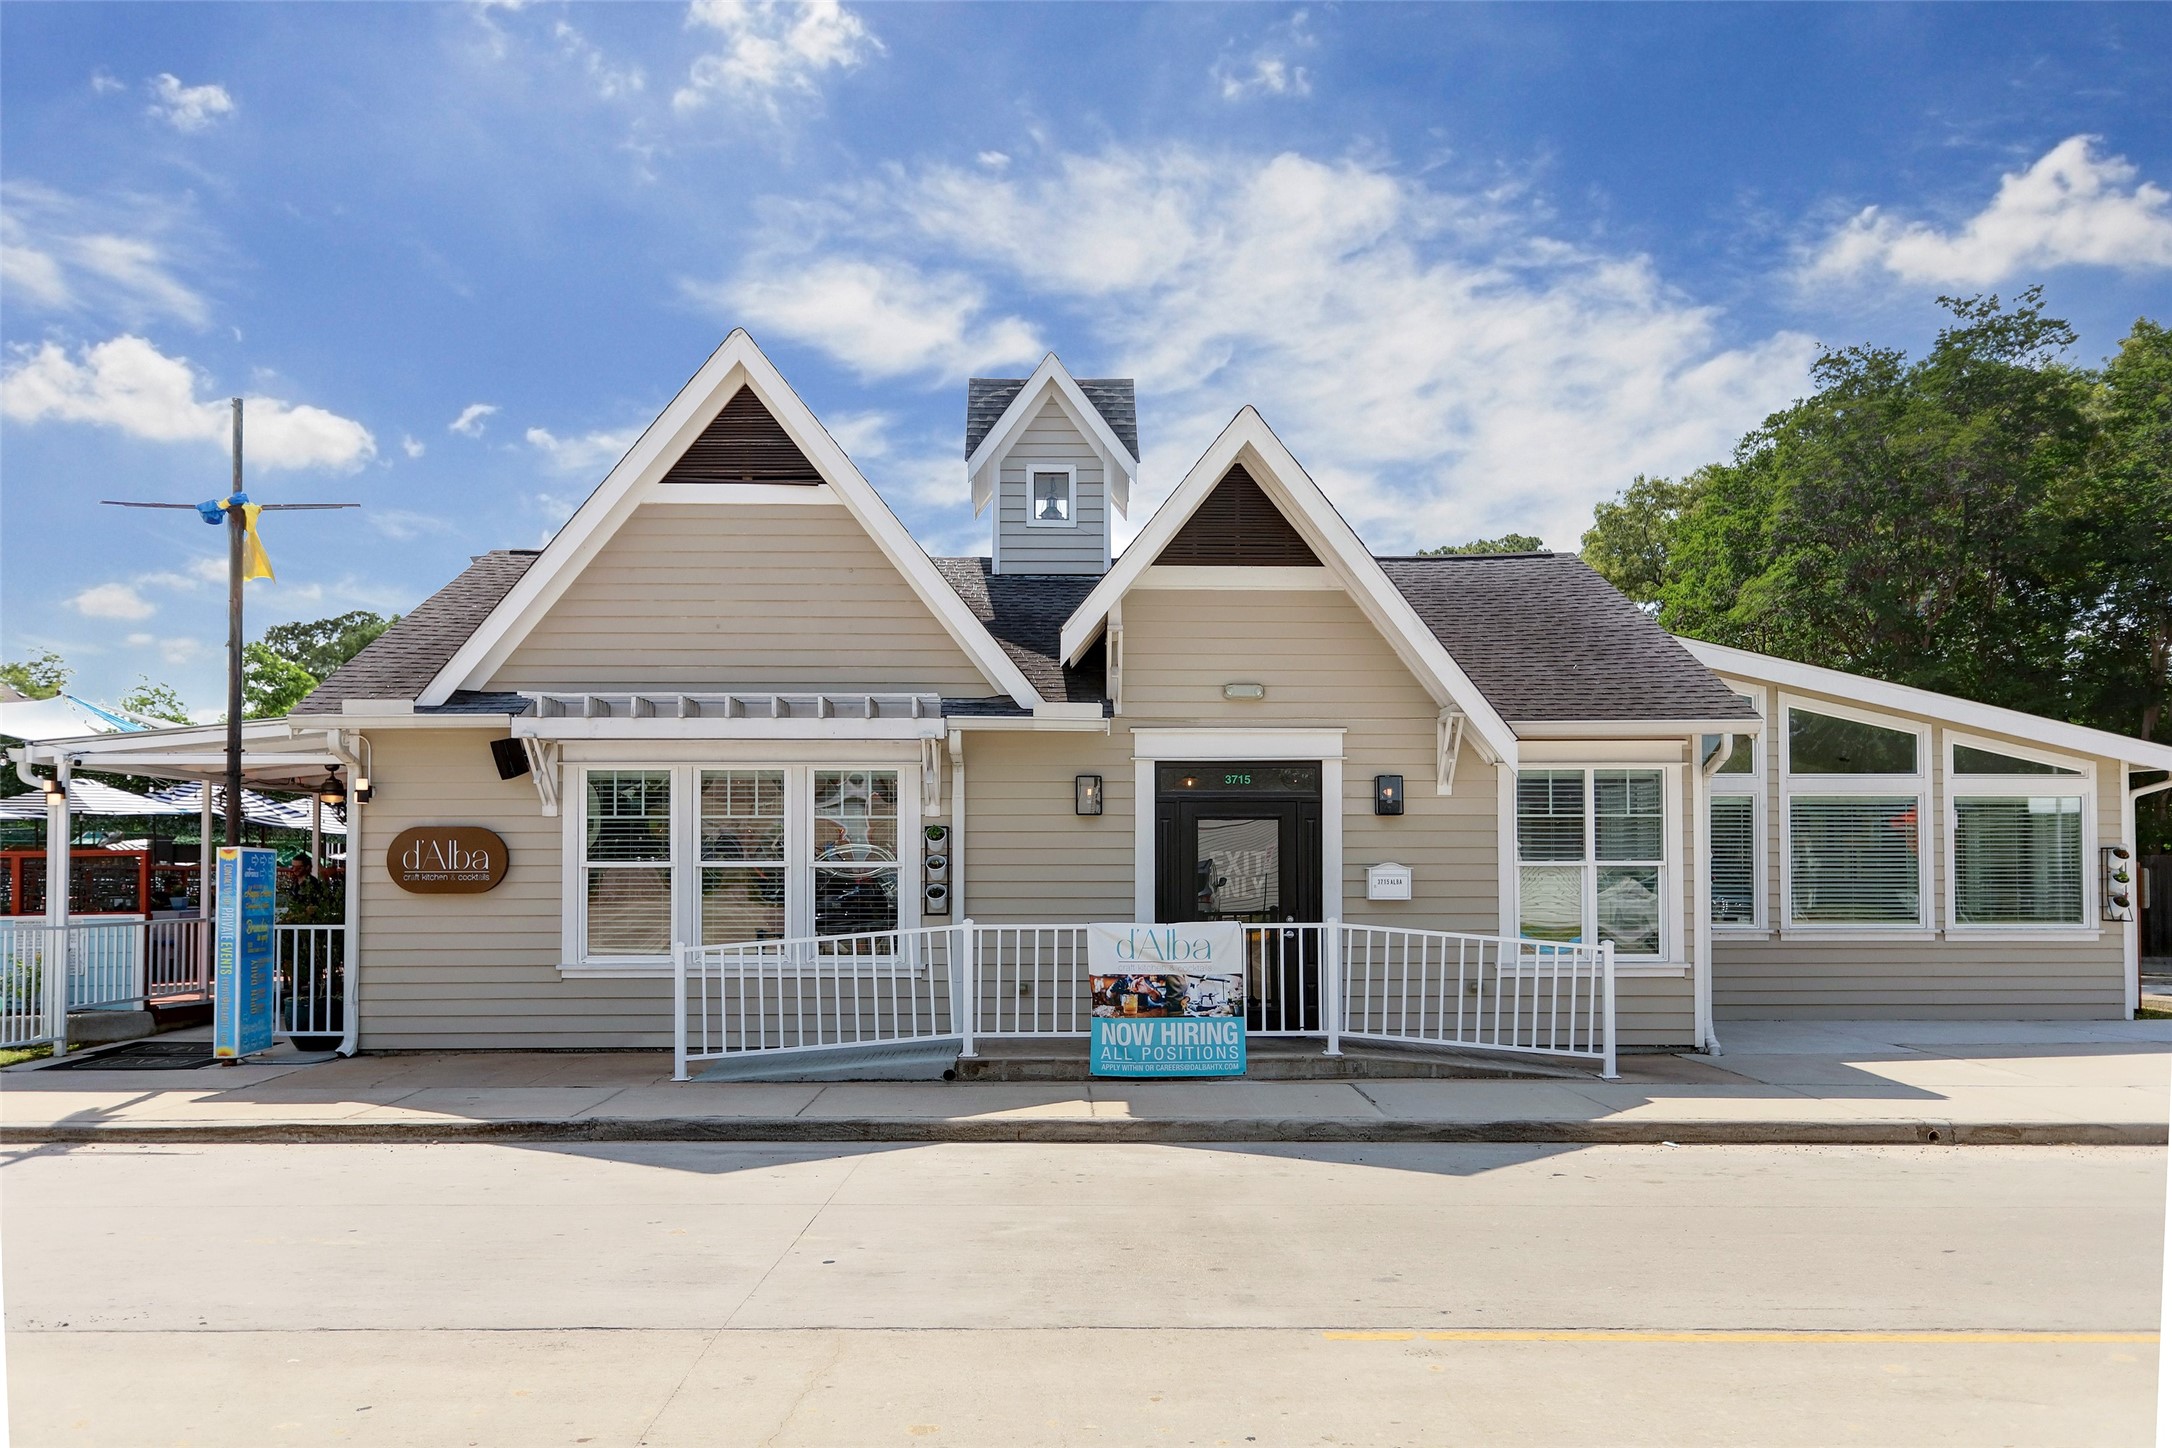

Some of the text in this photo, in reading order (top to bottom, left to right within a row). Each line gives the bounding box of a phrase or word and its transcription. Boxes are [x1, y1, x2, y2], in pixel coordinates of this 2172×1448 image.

[1225, 774, 1251, 784] 3715
[402, 839, 489, 870] d'Alba
[1209, 850, 1266, 876] EXIT
[403, 873, 420, 881] craft
[421, 873, 448, 881] kitchen
[457, 873, 490, 881] cocktails
[1219, 876, 1265, 898] NLY
[221, 907, 234, 940] PRIVATE
[1116, 928, 1211, 960] d'Alba
[220, 942, 233, 975] EVENTS
[1118, 963, 1136, 973] craft
[1138, 963, 1167, 973] kitchen
[1177, 964, 1213, 973] cocktails
[1101, 1021, 1239, 1046] NOW HIRING
[1101, 1046, 1239, 1061] ALL POSITIONS
[1101, 1063, 1239, 1072] APPLY WITHIN OR CAREERS@DALBAHTX.COM
